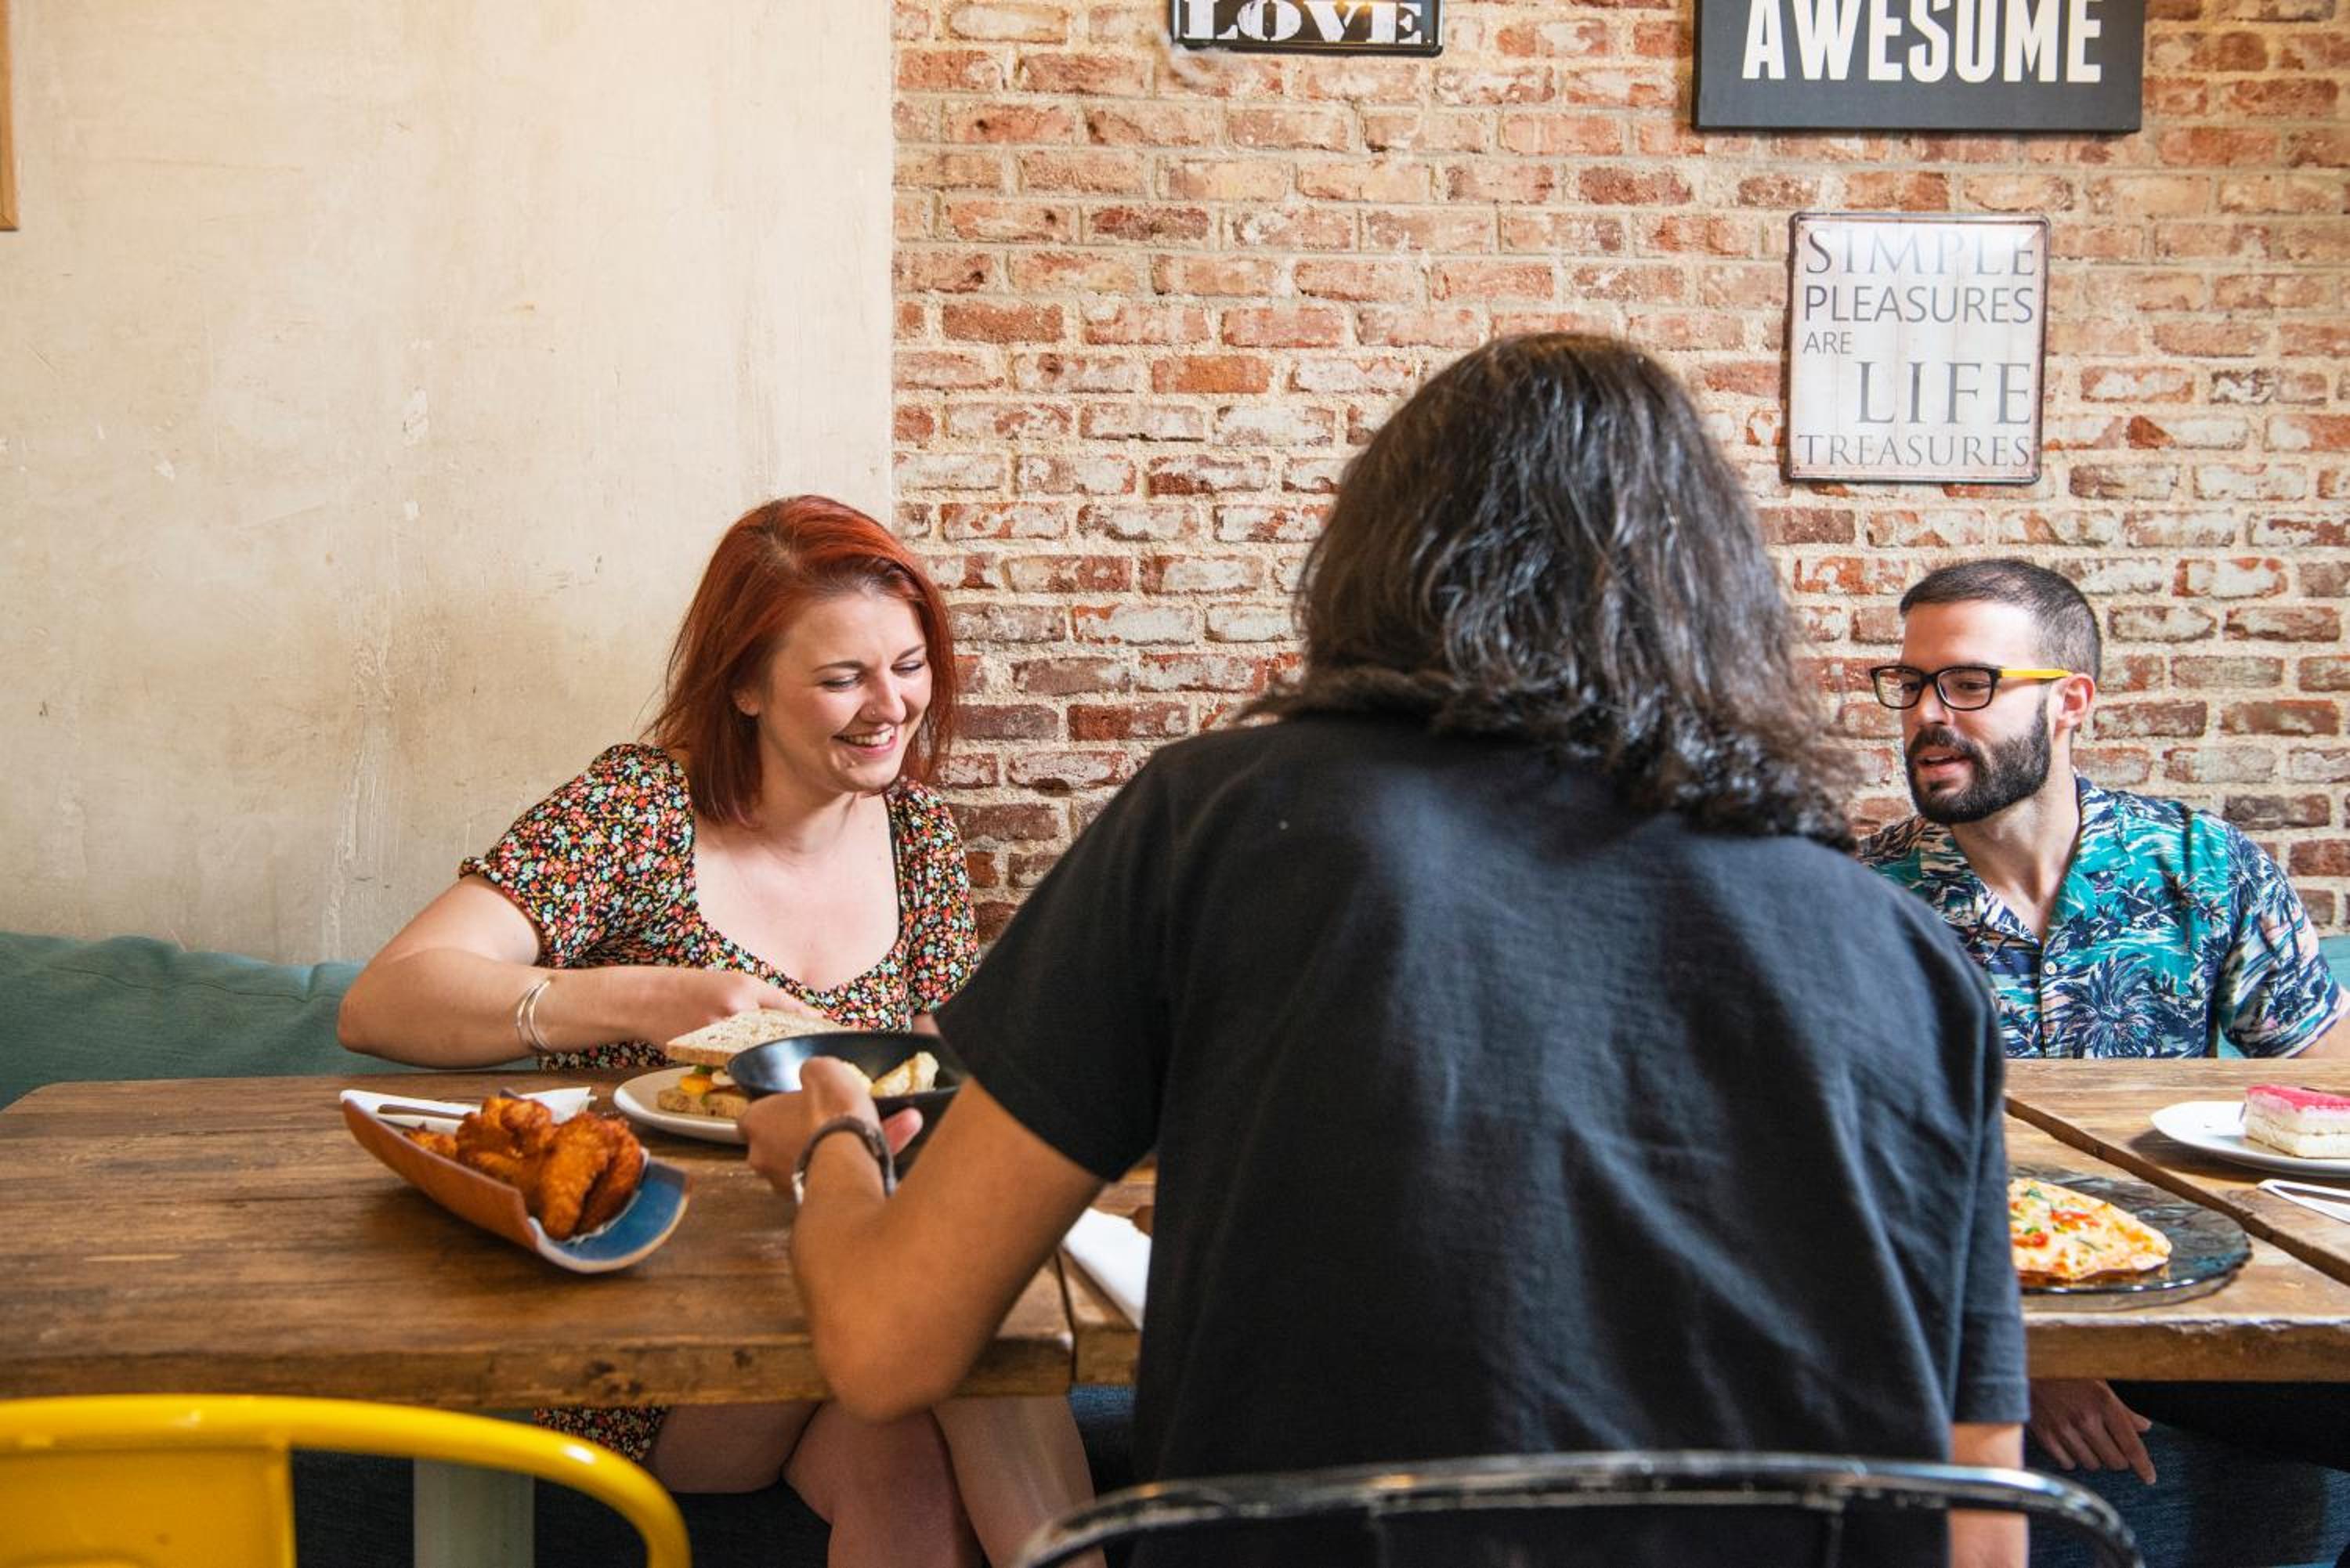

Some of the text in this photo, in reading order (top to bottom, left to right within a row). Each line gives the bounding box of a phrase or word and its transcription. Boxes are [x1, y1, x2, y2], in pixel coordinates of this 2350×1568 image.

[1742, 0, 2102, 82] AWESOME
[1805, 226, 2034, 276] SIMPLE
[1805, 284, 2034, 324] PLEASURES
[1802, 331, 1853, 354] ARE
[1855, 361, 2032, 425] LIFE
[1797, 434, 2030, 468] TREASURES
